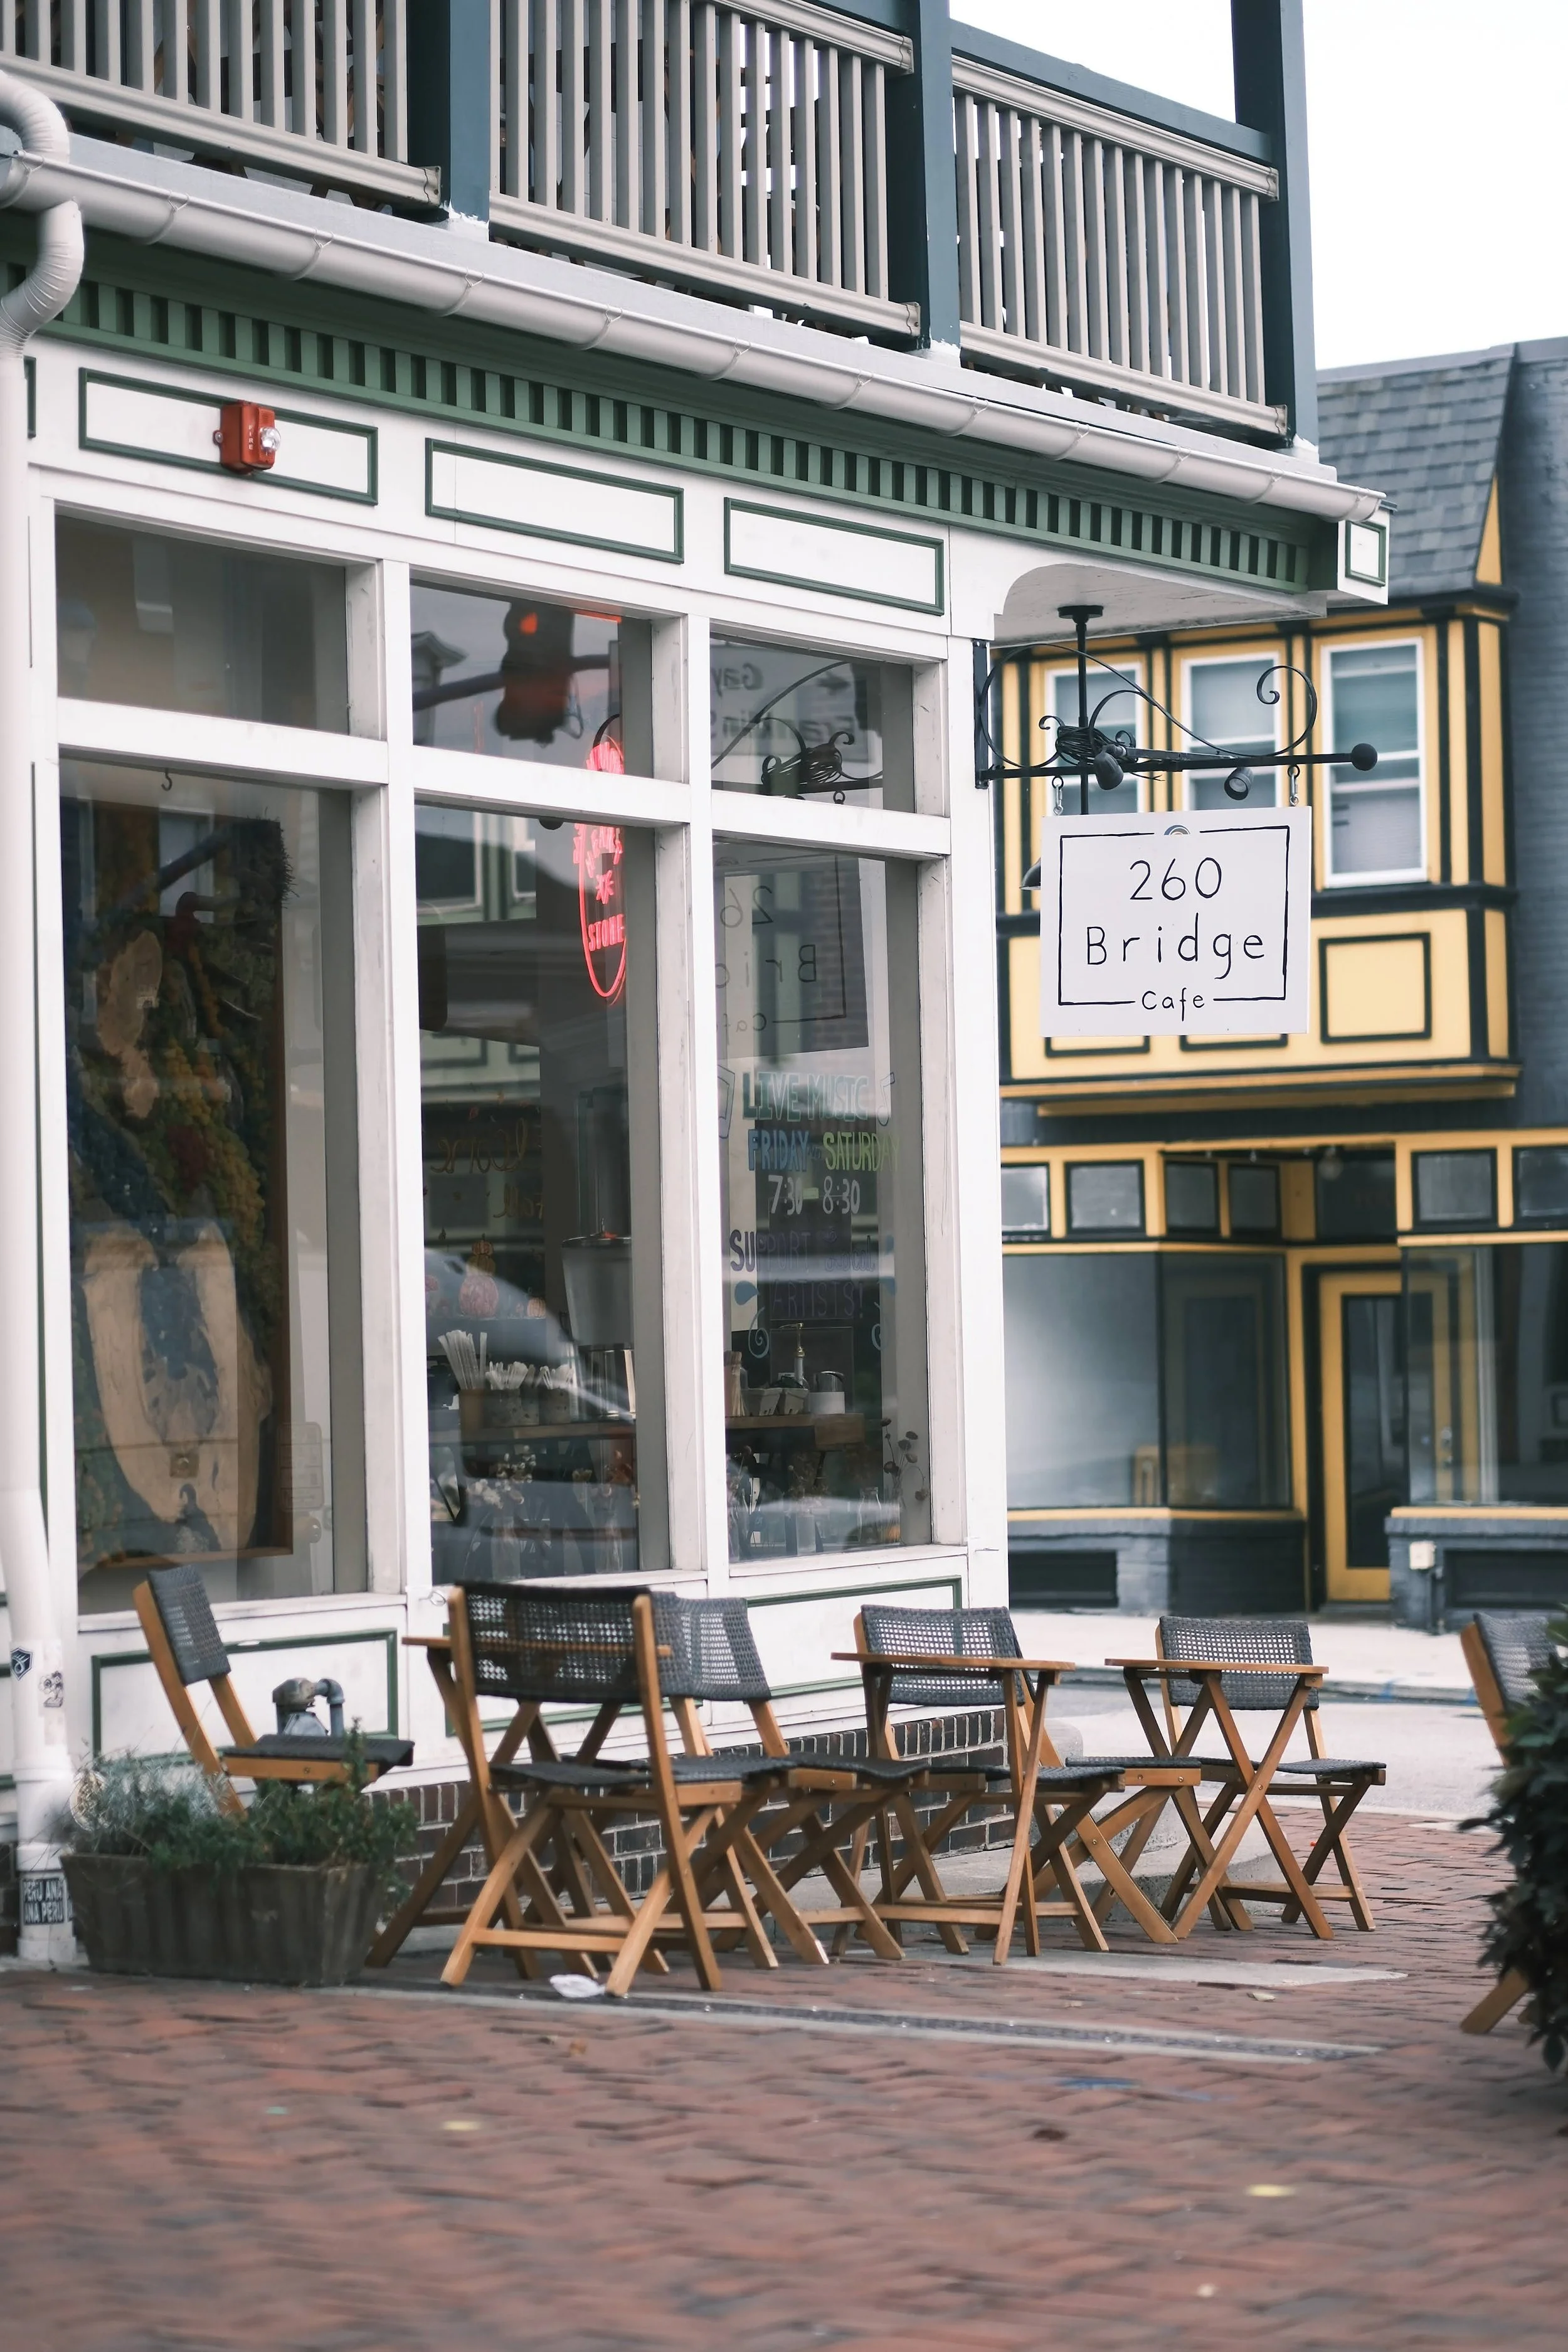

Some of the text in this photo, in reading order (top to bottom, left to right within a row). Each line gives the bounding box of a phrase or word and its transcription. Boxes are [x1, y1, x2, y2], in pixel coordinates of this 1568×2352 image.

[1130, 857, 1222, 901] 260
[1086, 912, 1265, 980] Bridge
[1141, 987, 1205, 1022] Cafe
[742, 1071, 870, 1122] LIVE MUSIC
[748, 1128, 810, 1172] FRIDAY
[823, 1131, 901, 1172] SATURDAY
[768, 1174, 861, 1216] 7:30 8:30
[728, 1229, 811, 1272] SUPPORT
[771, 1279, 864, 1318] ARTISTS!
